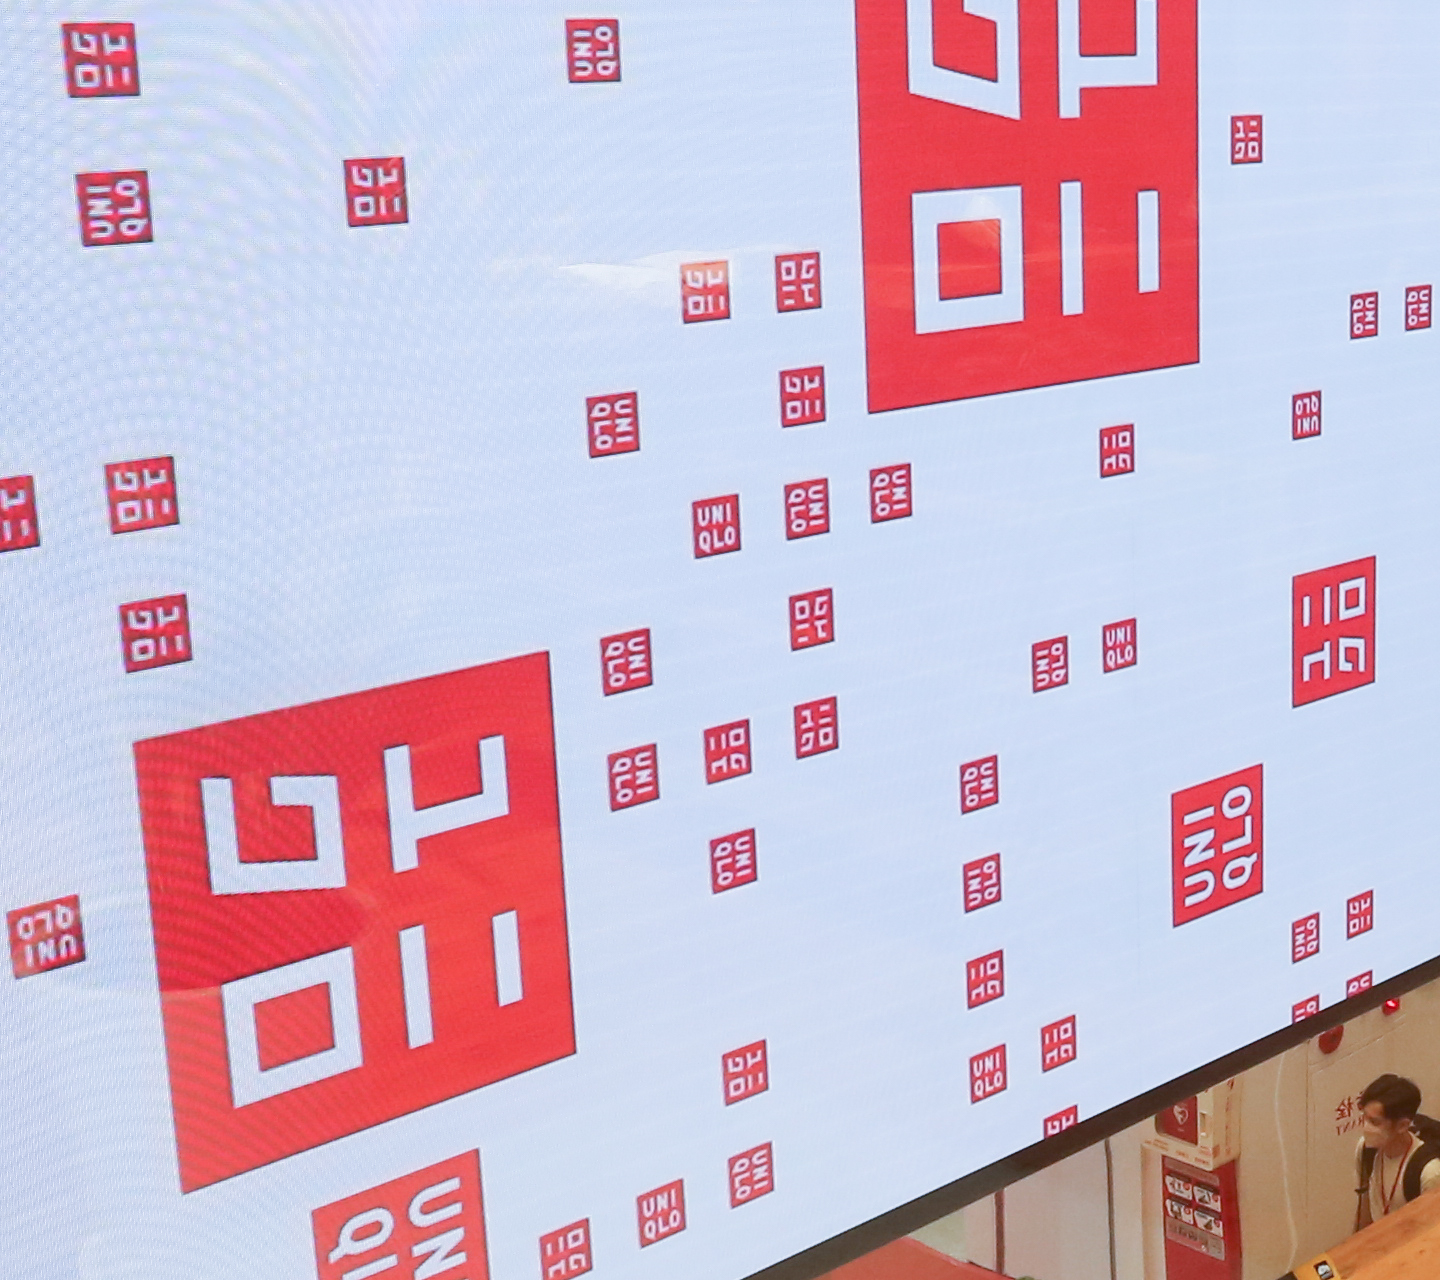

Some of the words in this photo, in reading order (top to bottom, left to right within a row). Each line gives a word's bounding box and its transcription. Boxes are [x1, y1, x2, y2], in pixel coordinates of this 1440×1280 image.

[572, 30, 593, 74] UNI
[593, 25, 615, 73] QLO
[590, 402, 611, 448] QLO
[612, 399, 631, 442] UNI
[698, 502, 731, 526] UNI
[699, 524, 735, 551] QLO
[1303, 584, 1331, 679] ユニ
[1338, 575, 1364, 670] クロ
[604, 641, 627, 686] QLO
[626, 635, 646, 678] UNI
[1183, 805, 1216, 906] UNI
[1221, 784, 1258, 889] QLO
[382, 736, 525, 1049] ユニ
[17, 902, 73, 939] QLO
[199, 777, 363, 1108] クロ
[25, 930, 76, 965] UNI
[642, 1189, 675, 1218] UNI
[644, 1209, 679, 1239] QLO
